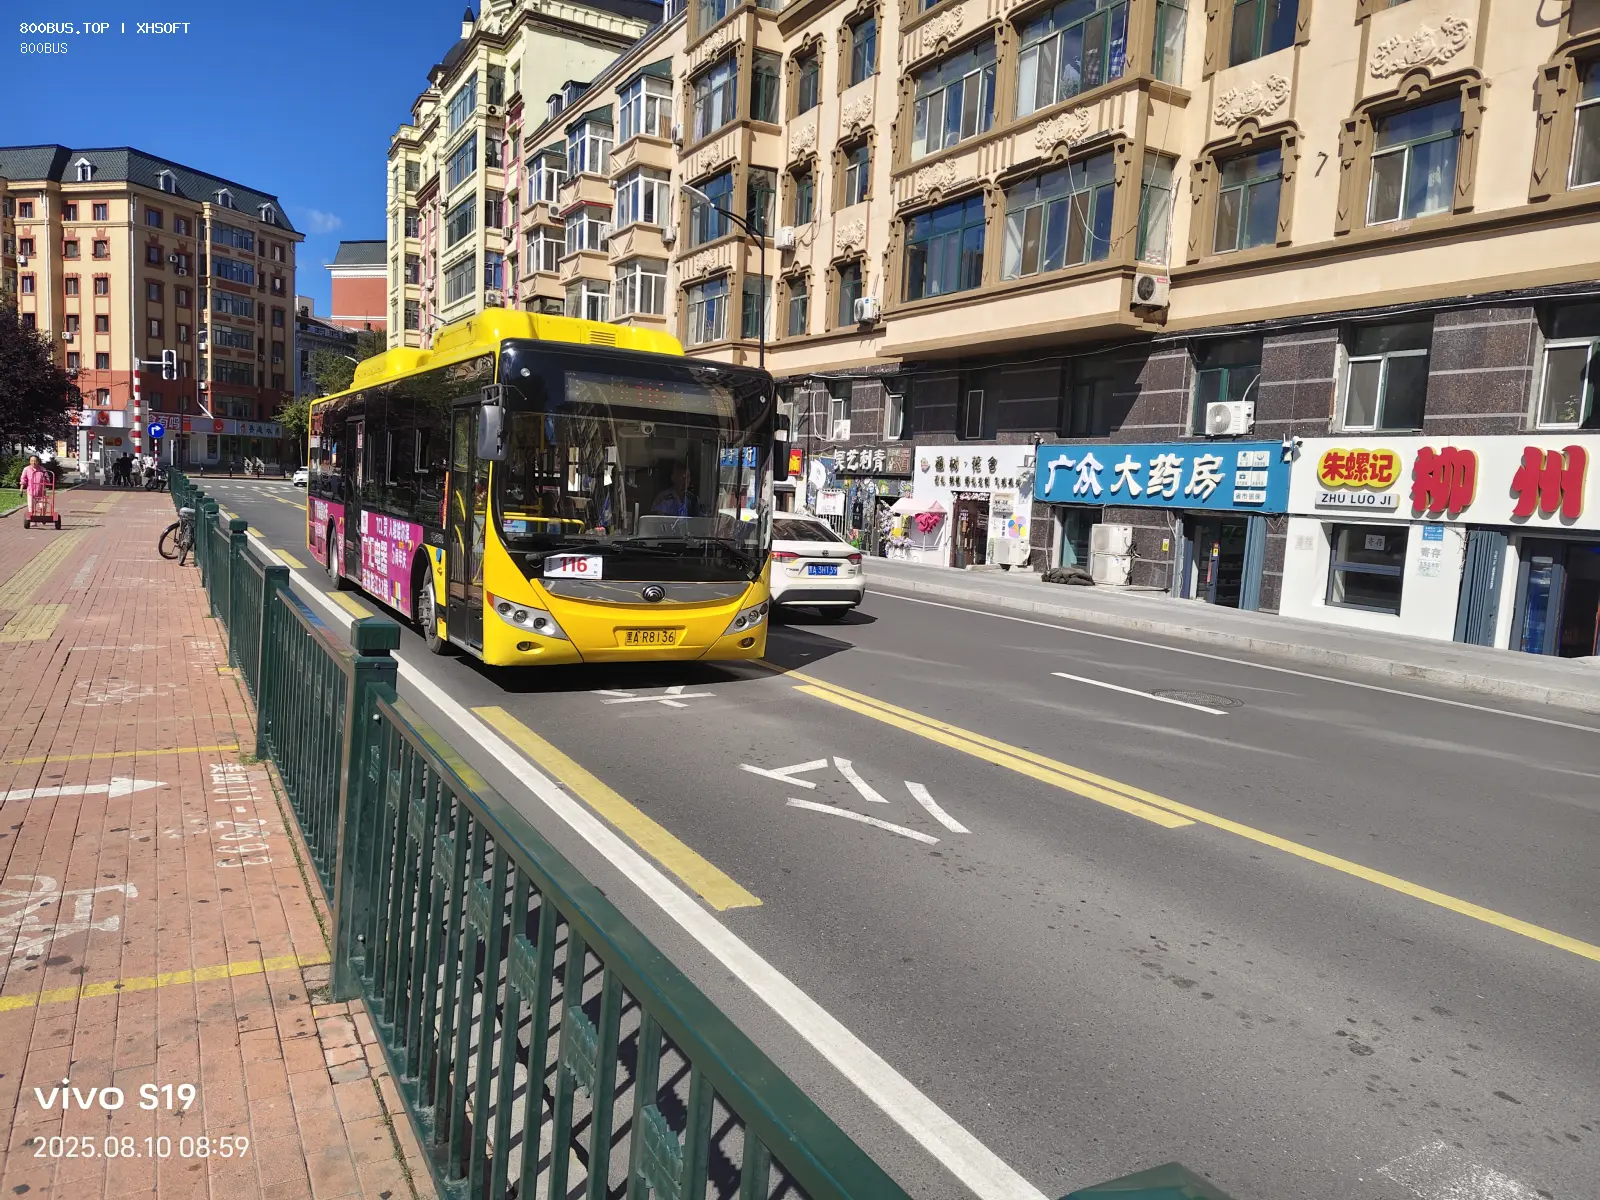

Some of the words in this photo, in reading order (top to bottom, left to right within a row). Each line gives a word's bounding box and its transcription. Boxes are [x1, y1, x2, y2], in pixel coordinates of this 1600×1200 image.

[1044, 452, 1226, 501] 广众大药房
[1321, 451, 1394, 483] 朱螺记
[1411, 445, 1590, 519] 柳州
[1321, 493, 1346, 504] ZHU
[1350, 494, 1376, 505] LUO
[1380, 495, 1392, 506] JI
[560, 556, 588, 572] 116
[1420, 547, 1442, 558] 寄存
